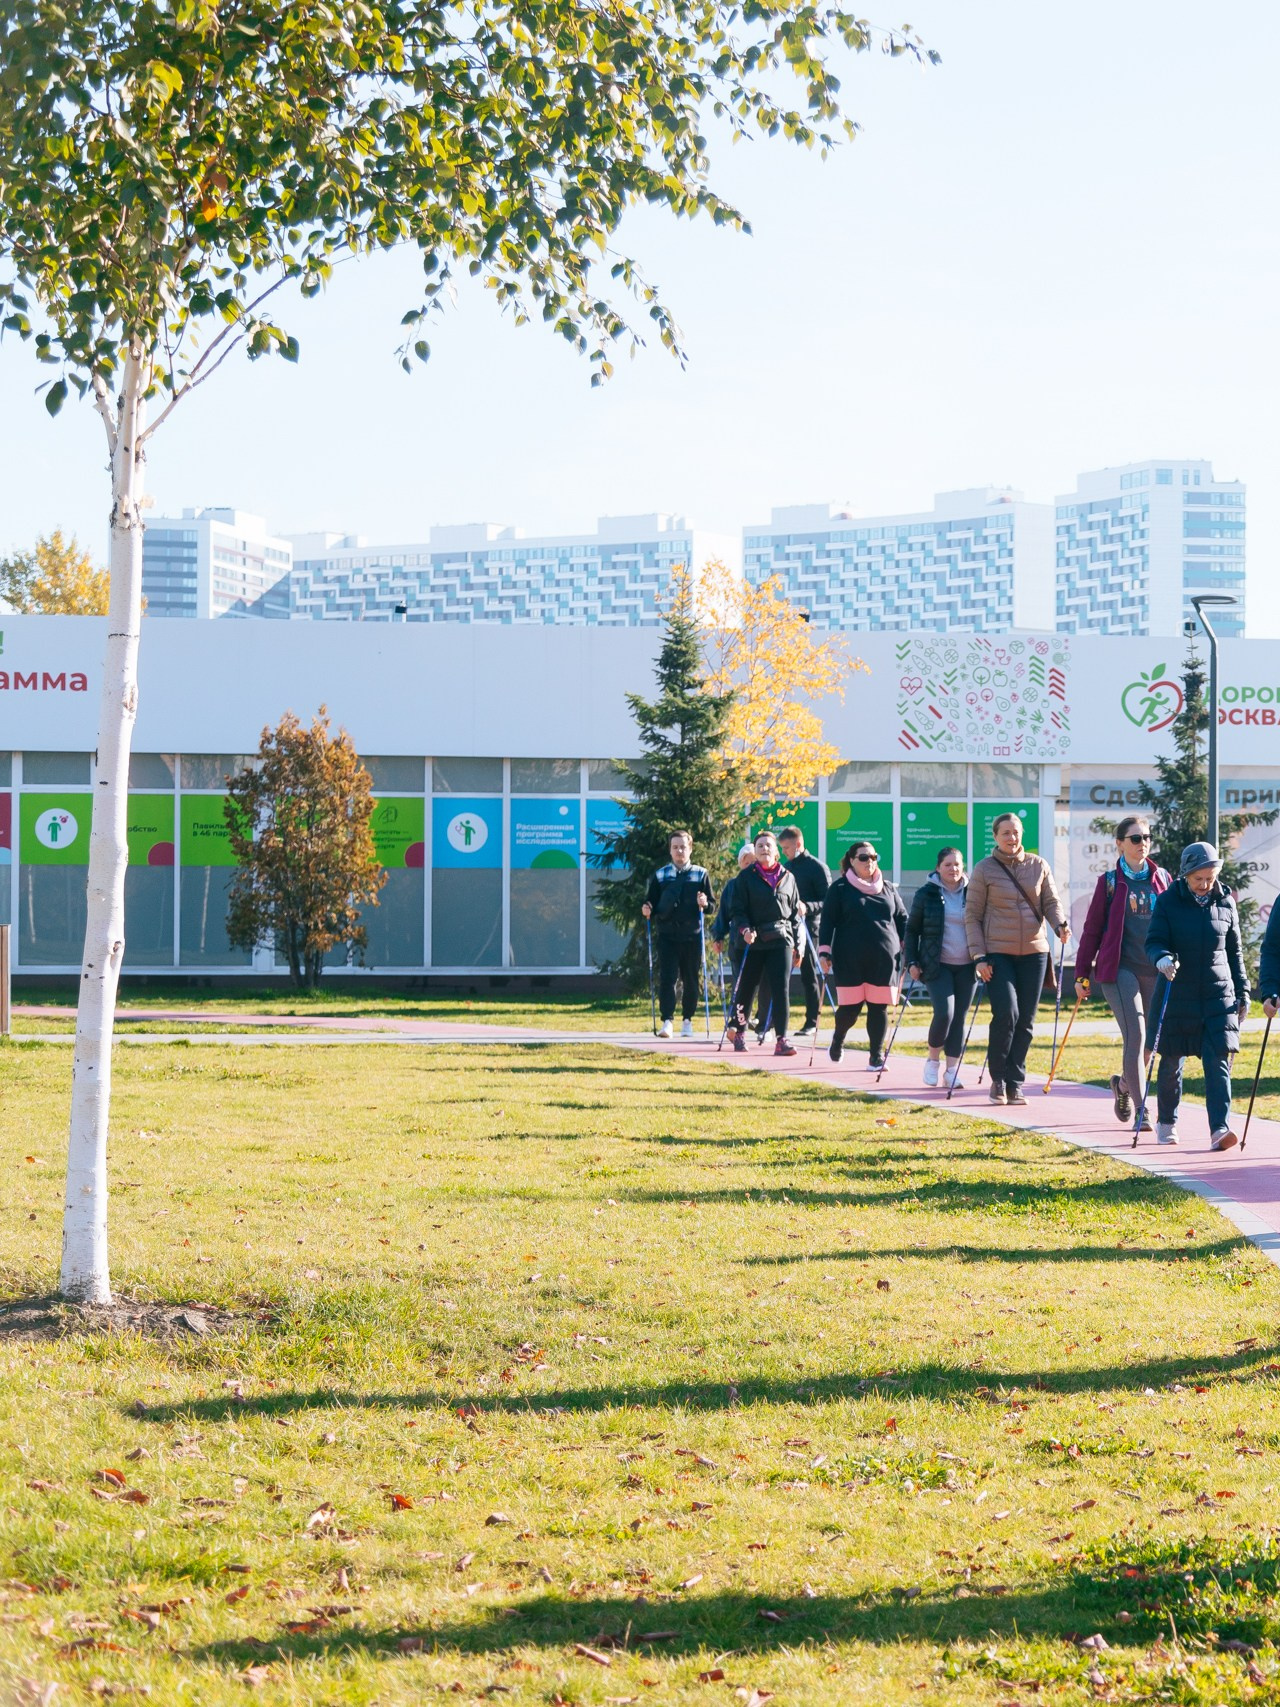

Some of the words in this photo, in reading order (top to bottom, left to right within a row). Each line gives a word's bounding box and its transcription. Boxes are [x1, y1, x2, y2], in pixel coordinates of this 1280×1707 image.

[128, 825, 157, 833] обство
[192, 822, 226, 830] Павиль
[516, 823, 575, 831] Расширенная
[516, 831, 563, 839] программа
